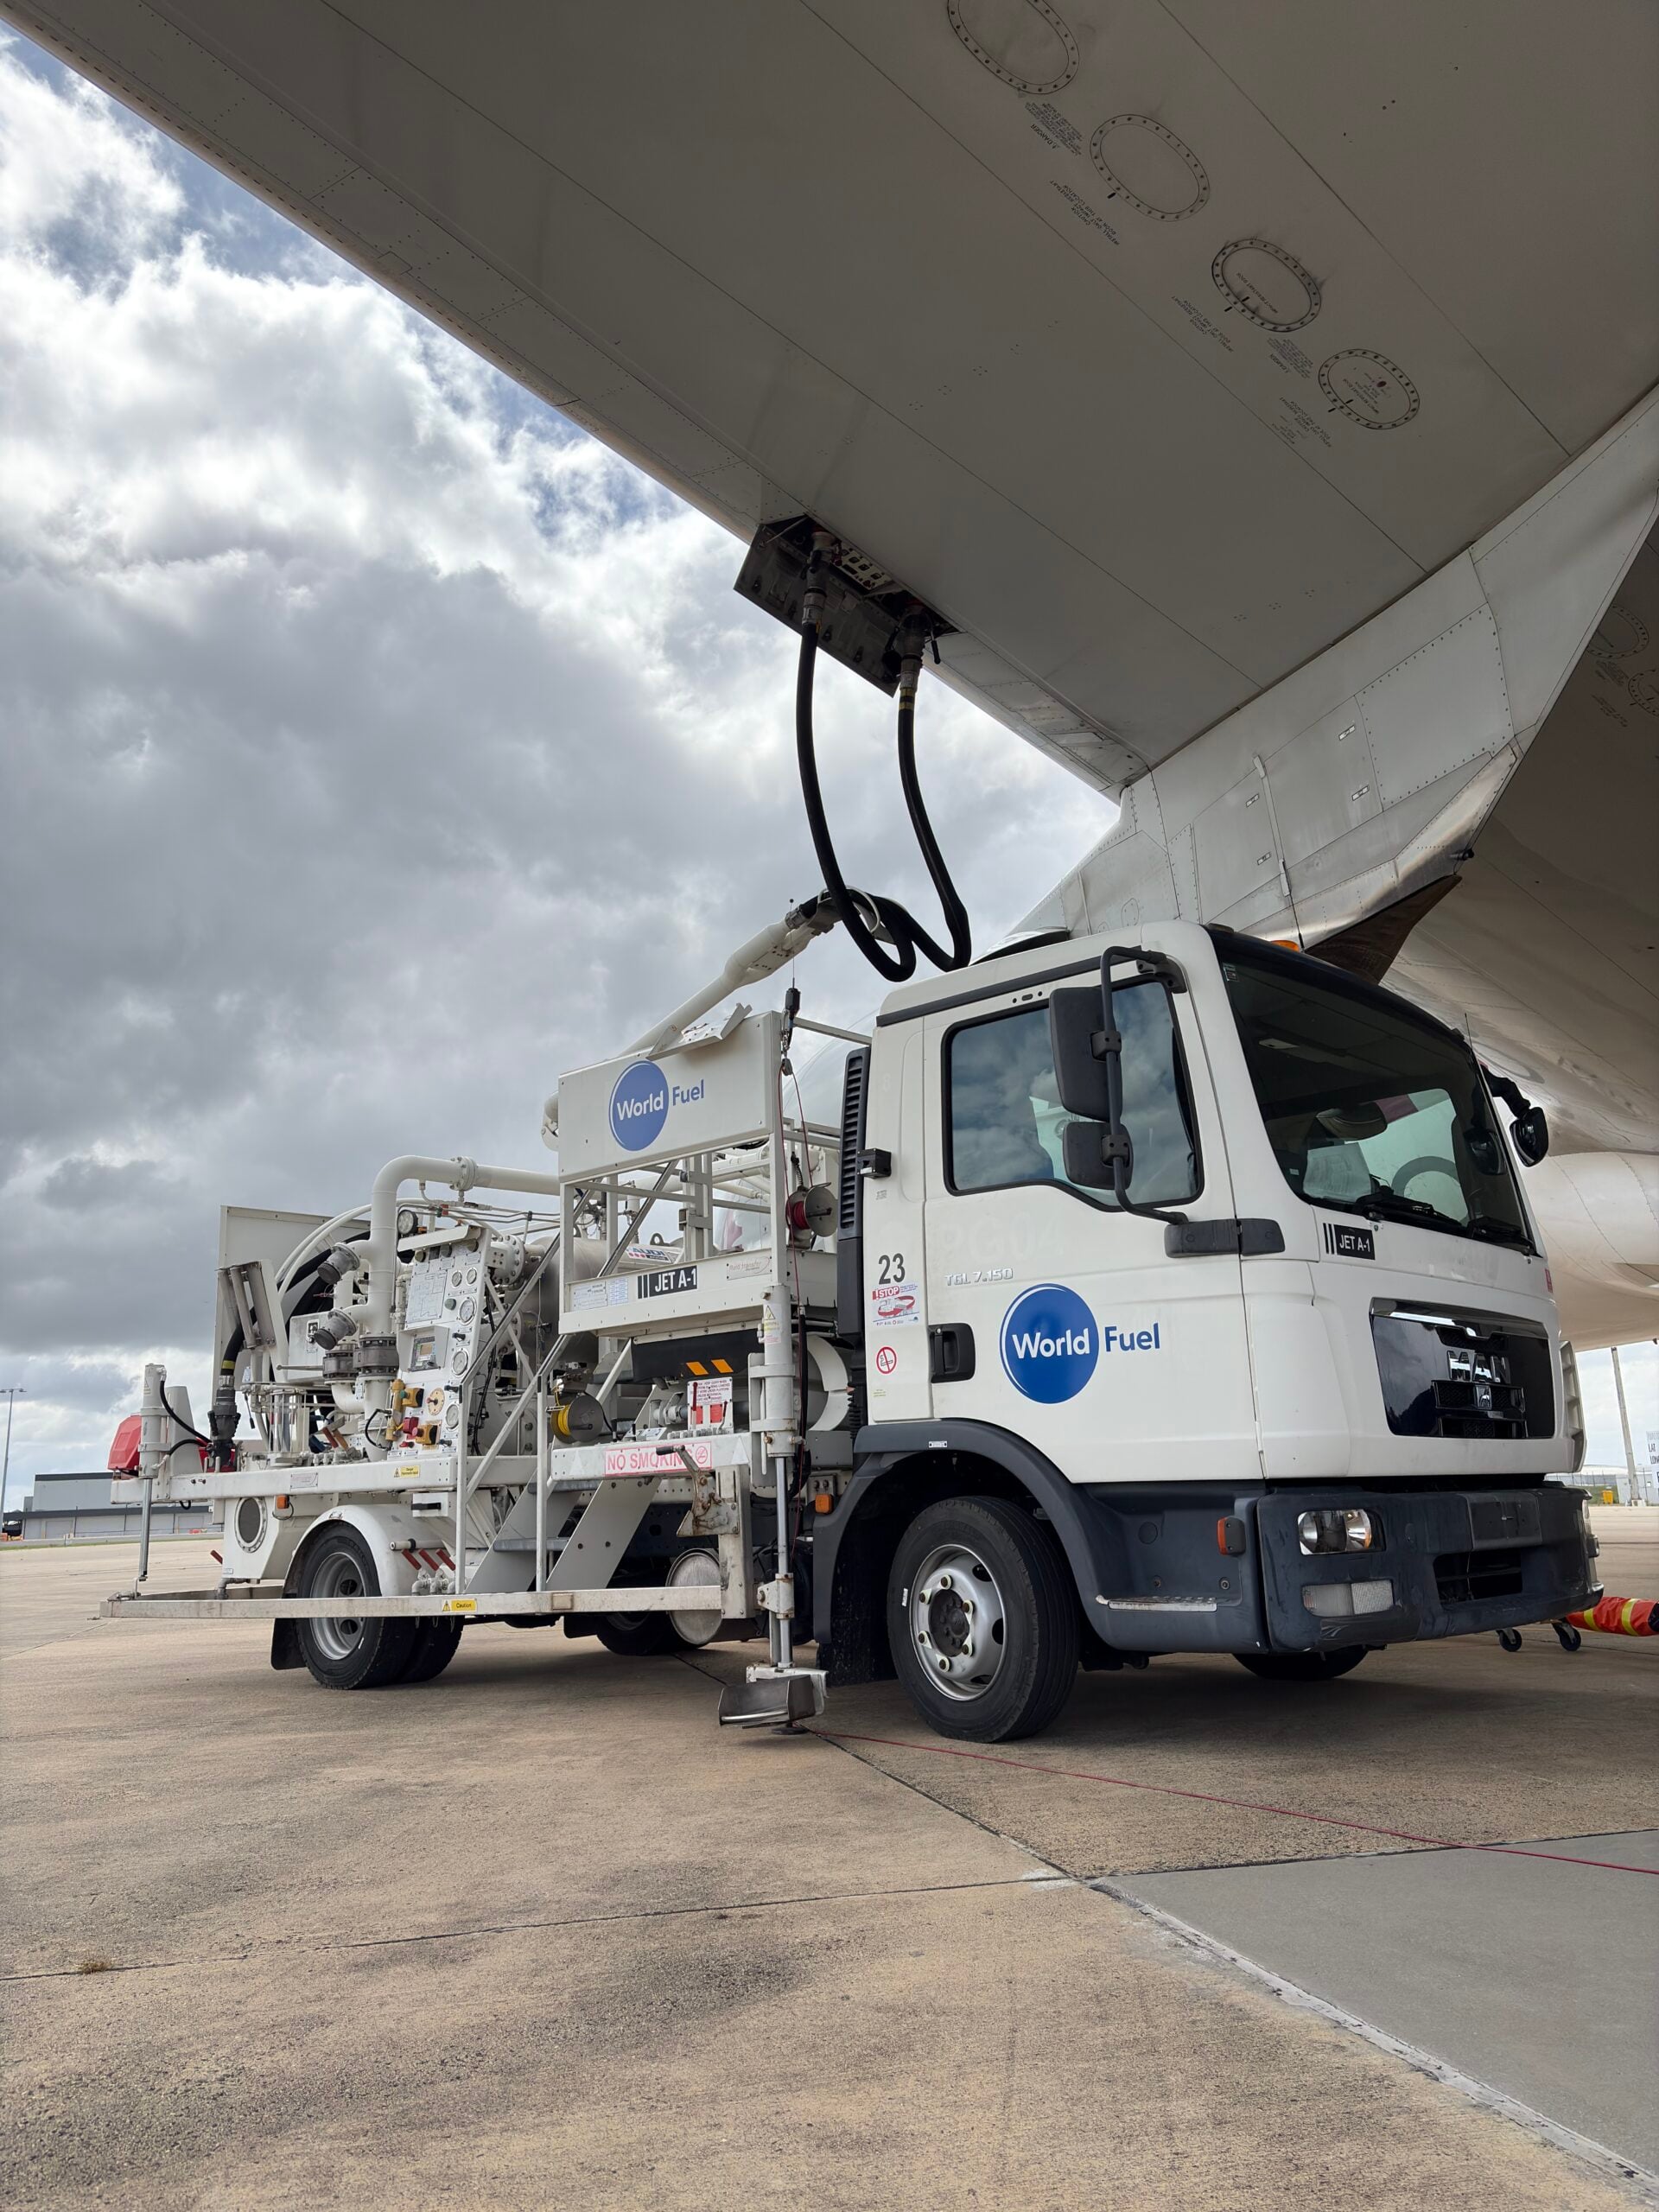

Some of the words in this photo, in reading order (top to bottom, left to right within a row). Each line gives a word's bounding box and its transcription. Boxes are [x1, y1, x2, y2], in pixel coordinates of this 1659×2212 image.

[616, 1090, 664, 1121] World
[672, 1078, 704, 1107] Fuel
[1339, 1235, 1355, 1249] JET
[1357, 1237, 1370, 1252] A-1
[654, 1271, 676, 1293] JET
[677, 1268, 696, 1288] A-1
[878, 1253, 906, 1285] 23
[944, 1274, 971, 1287] TGL
[972, 1268, 1014, 1283] 7.150
[1012, 1327, 1090, 1359] World
[1104, 1322, 1160, 1352] Fuel
[1446, 1350, 1511, 1384] MAN
[607, 1453, 626, 1471] NO
[630, 1449, 693, 1469] SMOKIN
